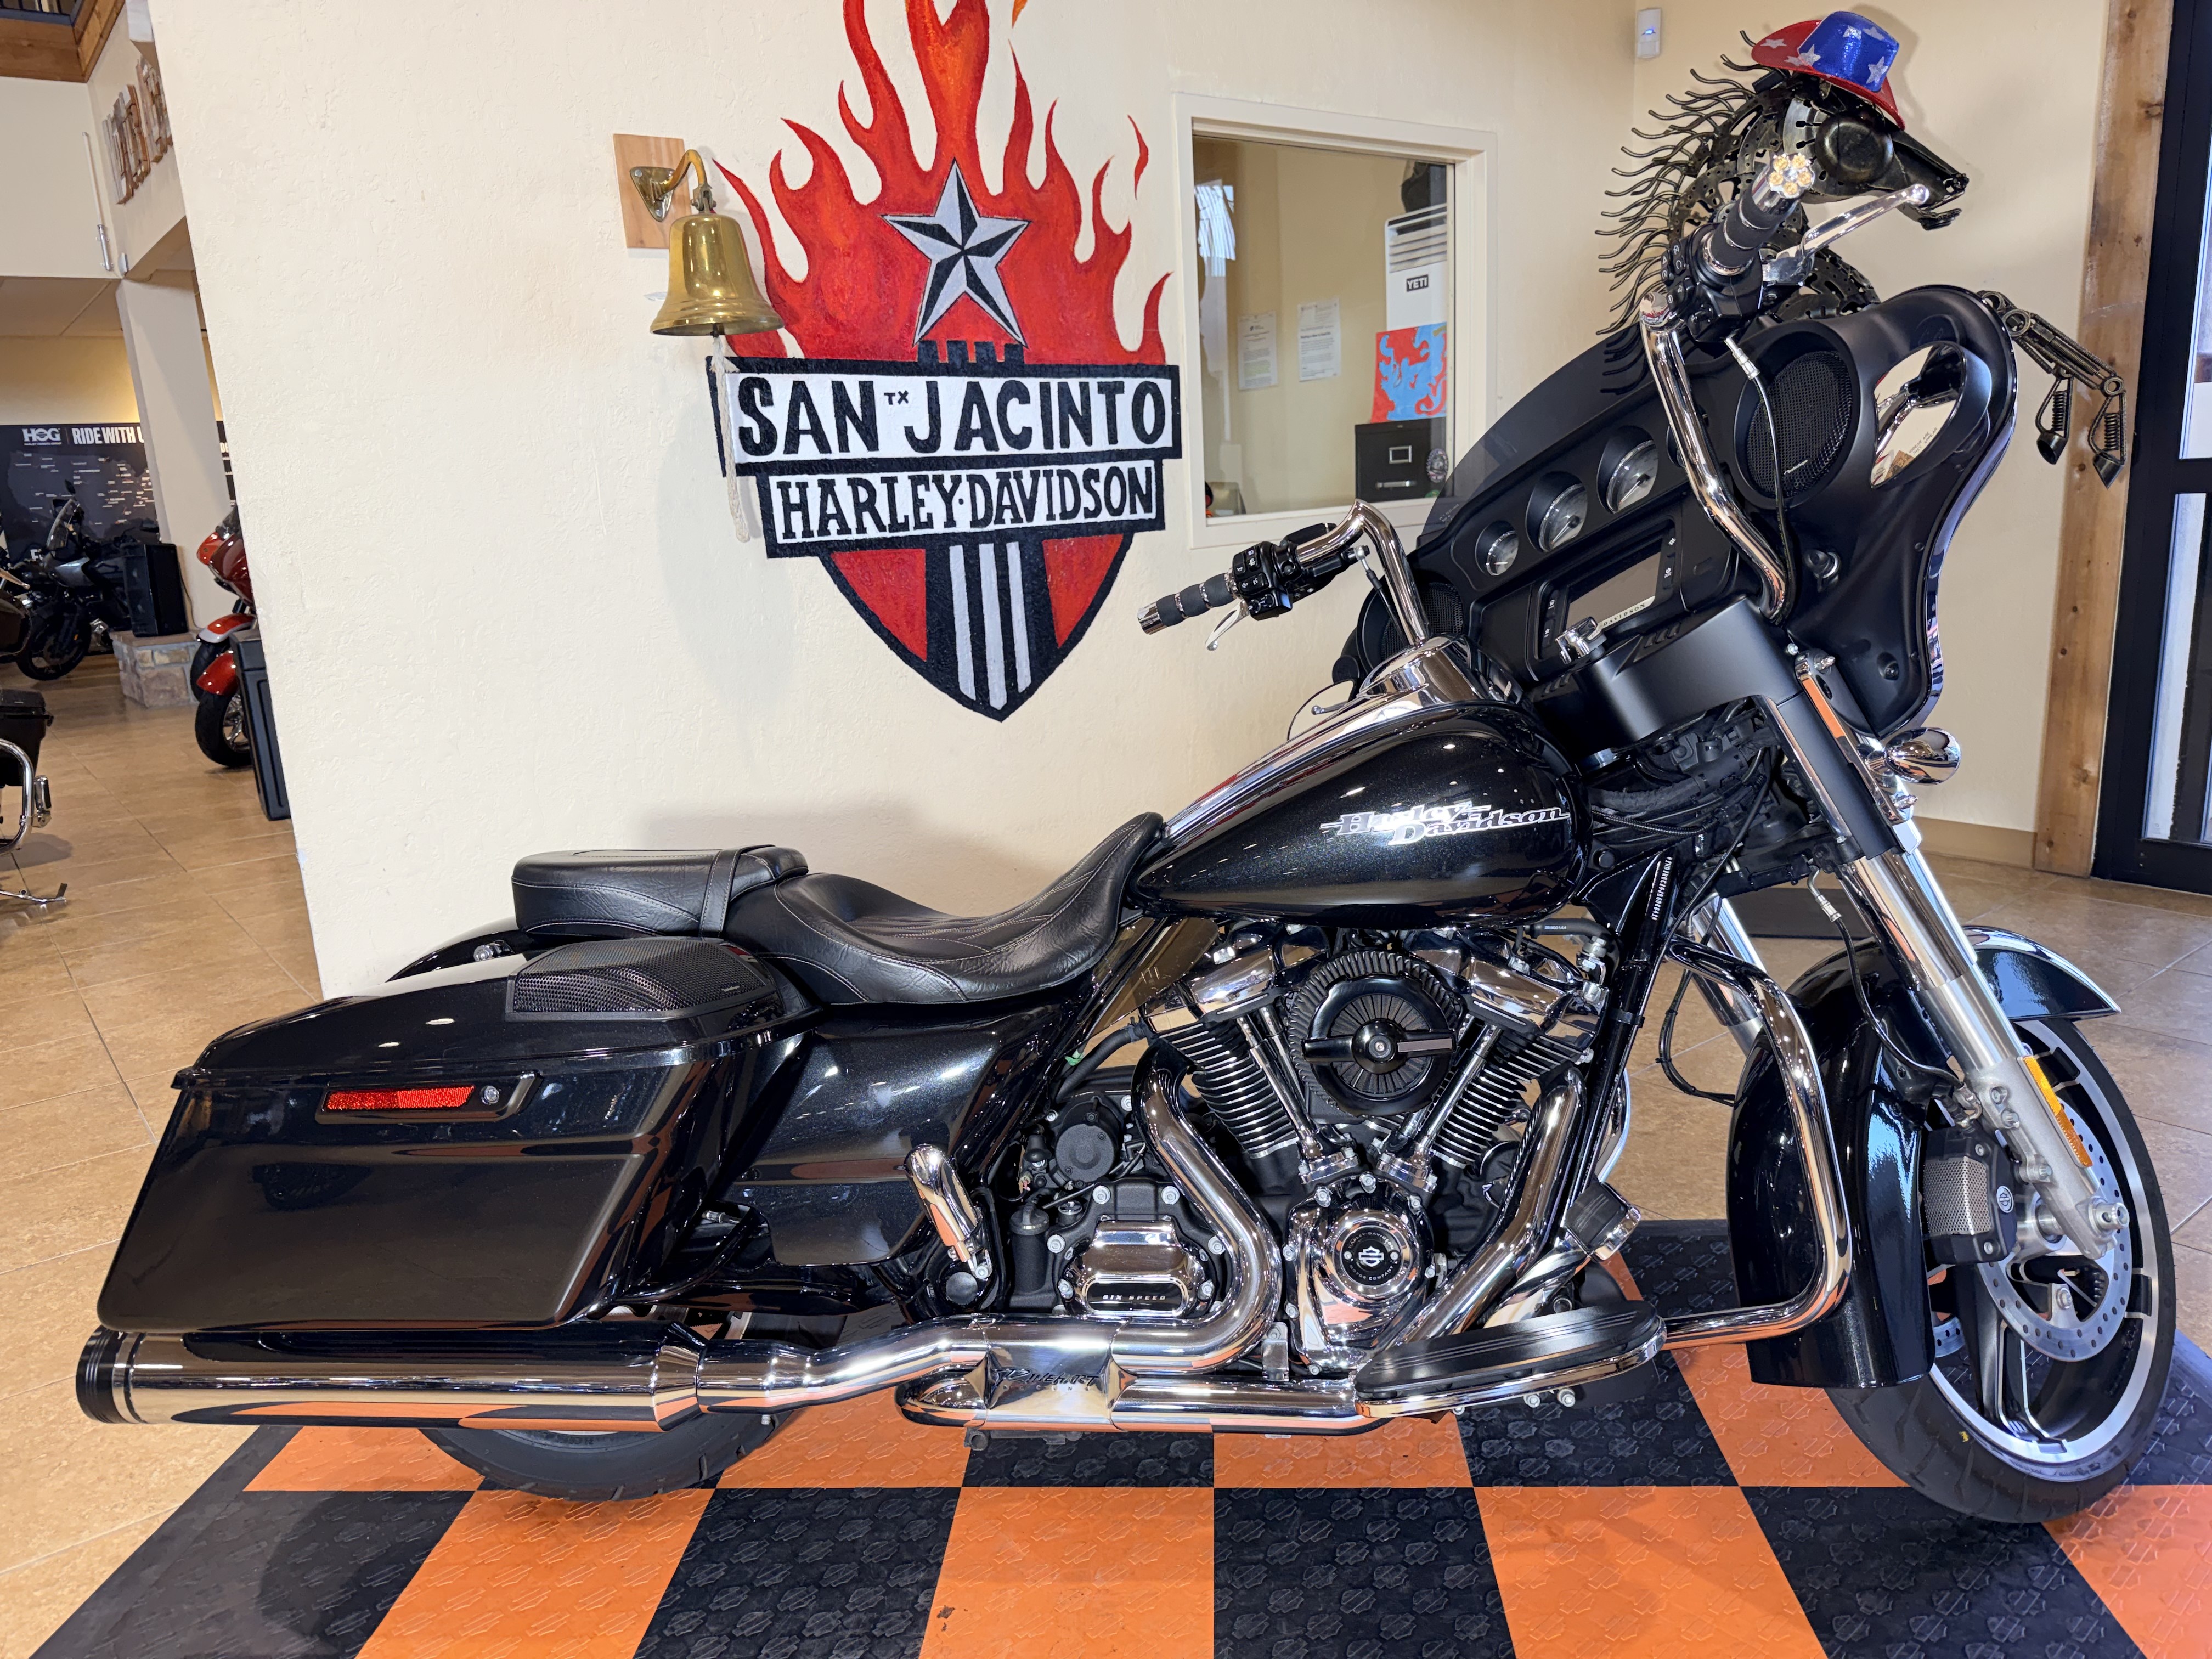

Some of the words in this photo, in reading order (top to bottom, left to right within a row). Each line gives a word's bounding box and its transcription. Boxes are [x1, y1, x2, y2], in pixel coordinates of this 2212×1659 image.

[1407, 276, 1427, 290] YETI
[738, 376, 879, 455] SAN
[884, 390, 910, 405] TX
[904, 380, 1166, 453] JACINTO
[22, 428, 61, 442] HOG
[72, 427, 101, 445] RIDE
[101, 426, 136, 444] WITH
[1320, 800, 1491, 836] Harley
[1387, 807, 1571, 846] Davidson
[1348, 1232, 1394, 1249] HARLEY-DAVIDSON
[1350, 1265, 1367, 1279] MOTOR
[1368, 1265, 1393, 1280] COMPANY
